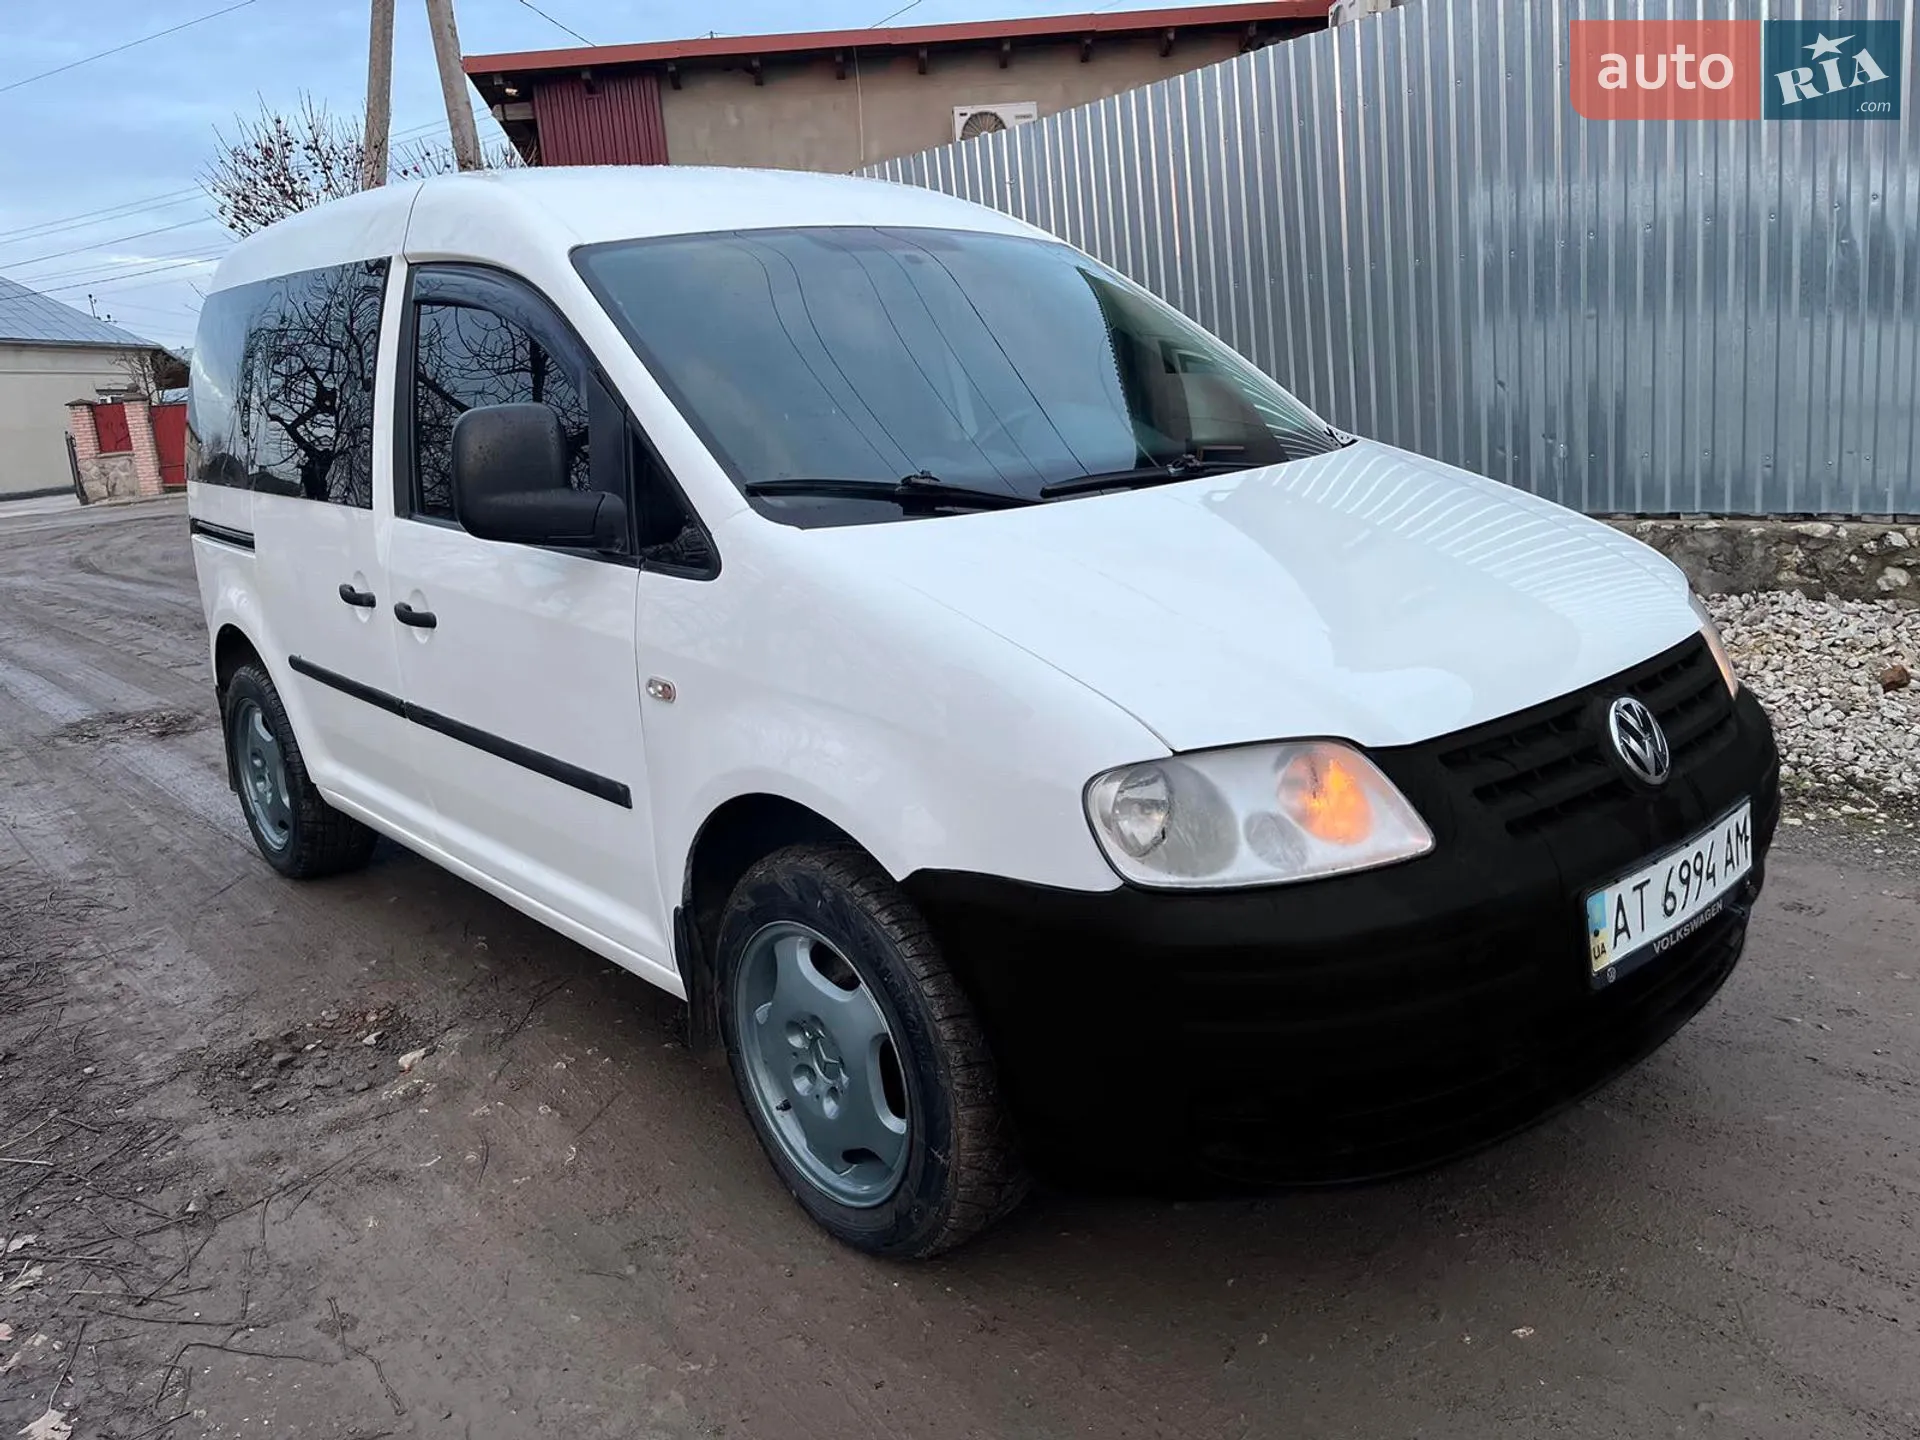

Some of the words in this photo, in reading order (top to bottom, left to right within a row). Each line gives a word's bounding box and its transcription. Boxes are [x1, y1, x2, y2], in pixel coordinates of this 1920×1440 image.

[1613, 878, 1651, 950] AT
[1663, 840, 1716, 918] 6994
[1724, 815, 1750, 879] AM
[1593, 942, 1607, 960] UA
[1653, 900, 1724, 954] VOLKSWAGEN
